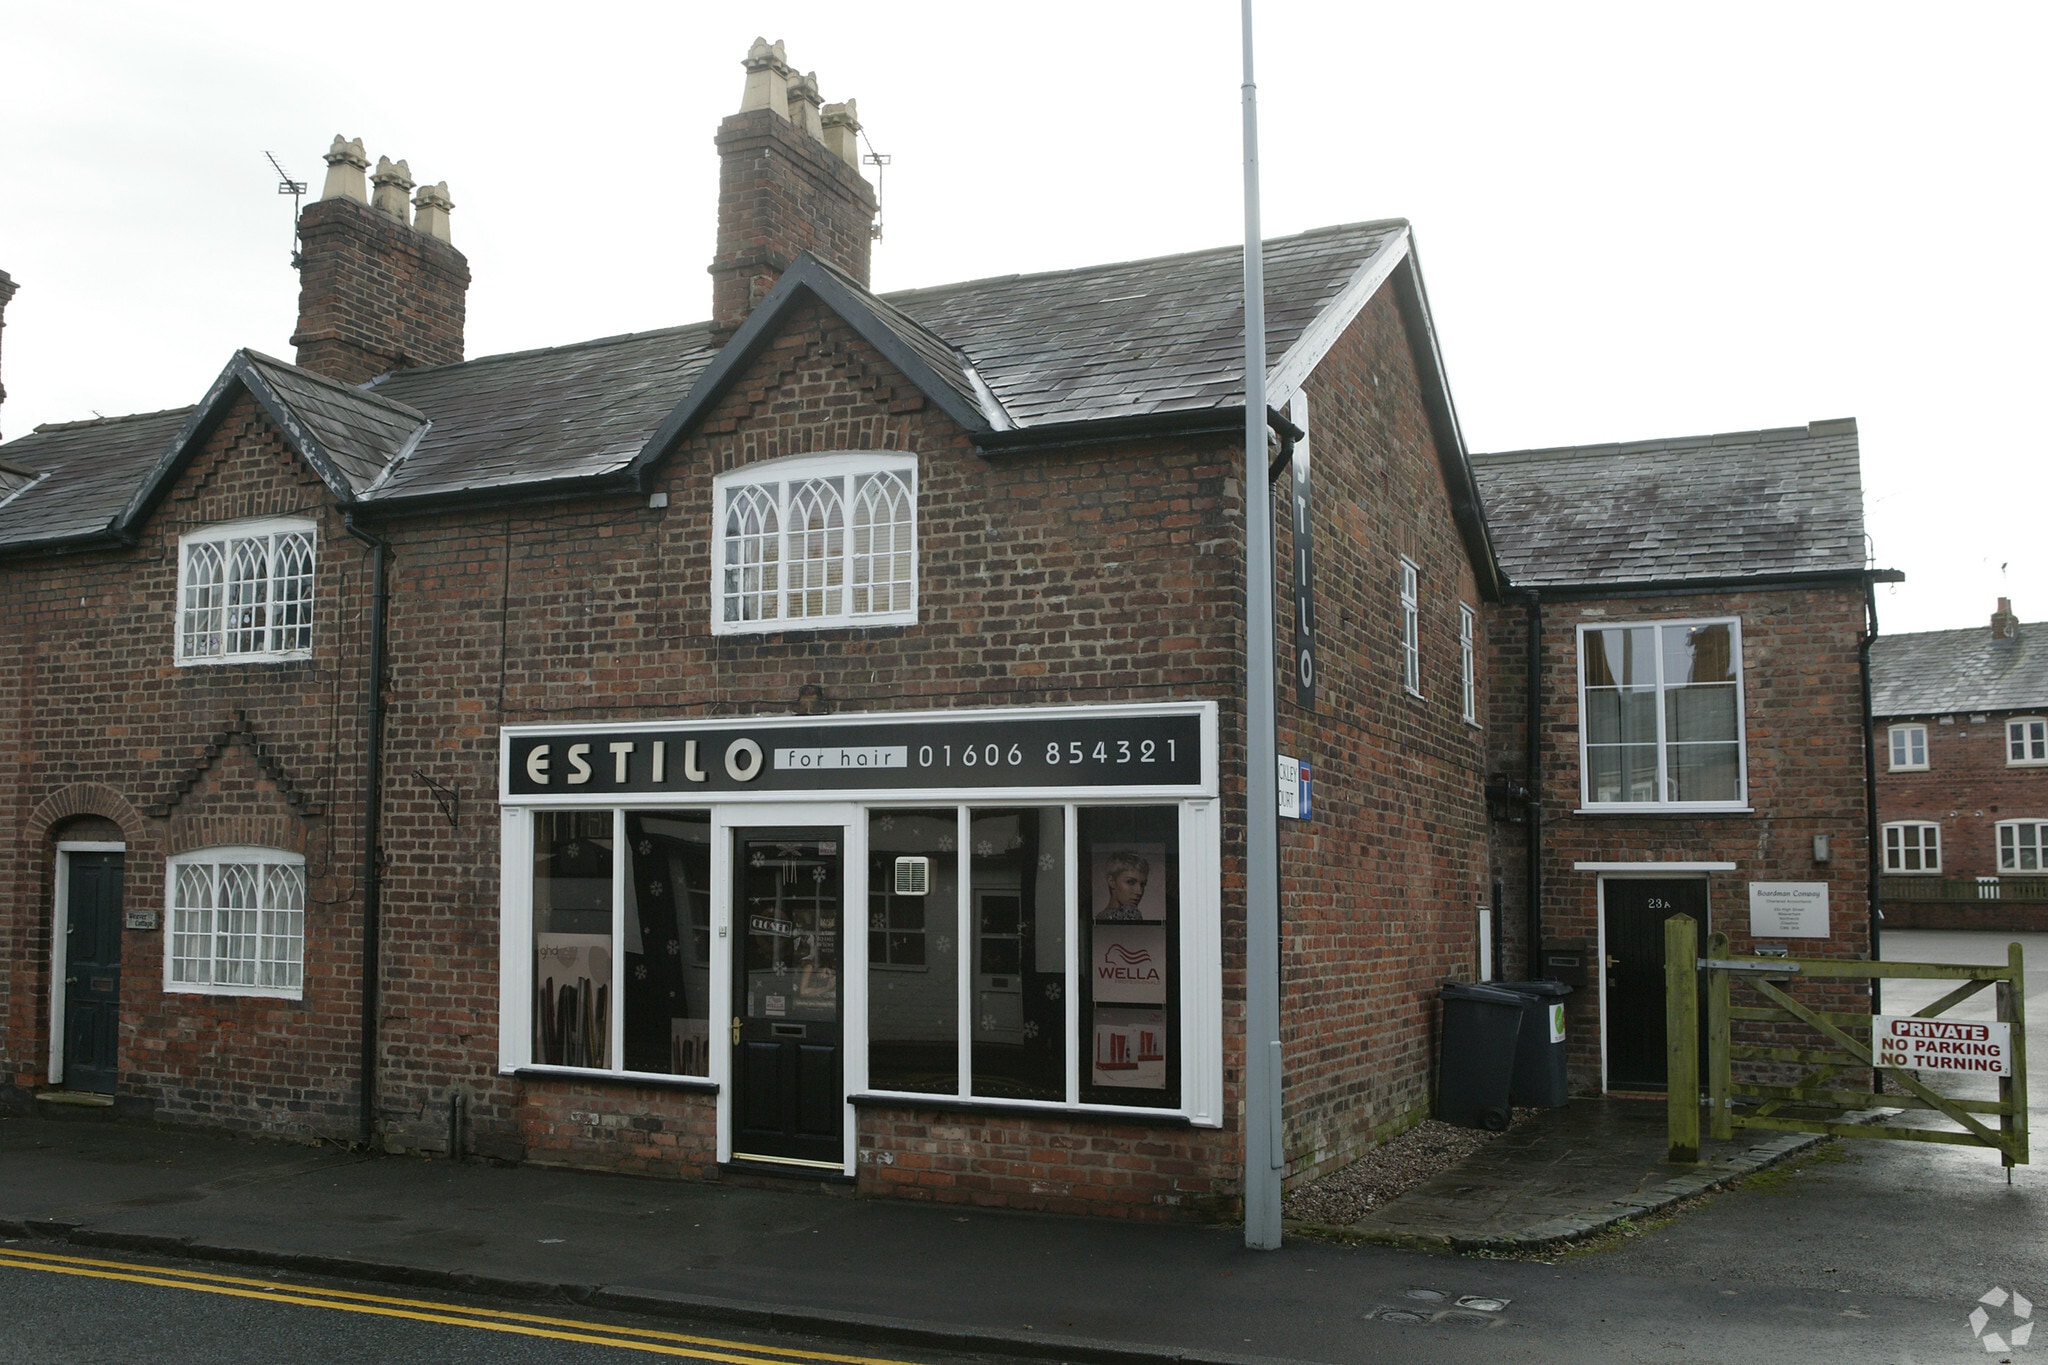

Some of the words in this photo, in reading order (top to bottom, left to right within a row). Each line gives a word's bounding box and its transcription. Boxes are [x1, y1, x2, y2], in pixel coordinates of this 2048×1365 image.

[1297, 404, 1313, 688] STILO
[526, 737, 763, 785] ESTILO
[788, 750, 824, 767] for
[841, 749, 892, 766] hair
[919, 743, 1022, 767] 01606
[1045, 739, 1176, 765] 854321
[1278, 763, 1298, 783] CKLEY
[1278, 790, 1294, 809] OURT
[1648, 898, 1671, 909] 23A
[1757, 889, 1791, 897] Boardman
[1792, 889, 1821, 899] Conway
[752, 918, 790, 933] CLOSED
[540, 944, 559, 960] ghd
[1098, 967, 1160, 981] WELLA
[1896, 1021, 1985, 1041] PRIVATE
[1881, 1038, 1908, 1051] NO
[1915, 1039, 2001, 1057] PARKING
[1880, 1052, 1908, 1066] NO
[1914, 1054, 2002, 1072] TURNING
